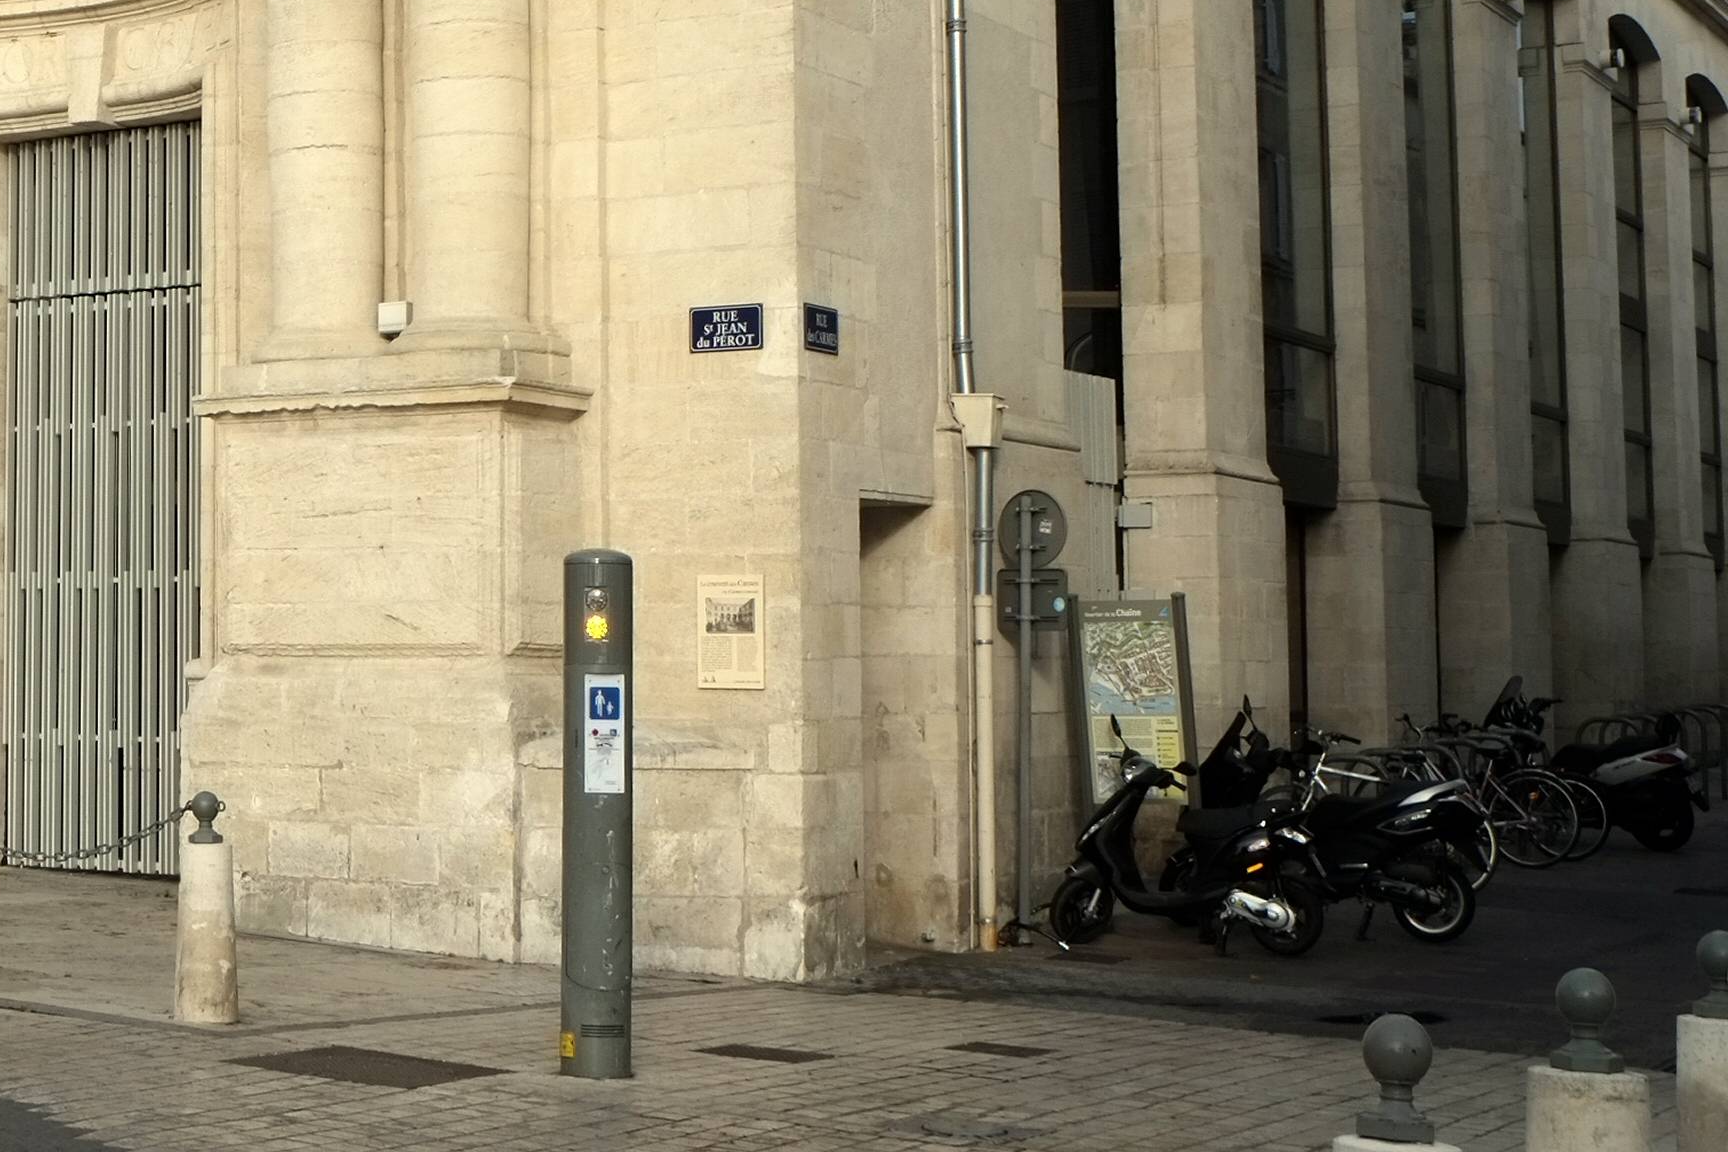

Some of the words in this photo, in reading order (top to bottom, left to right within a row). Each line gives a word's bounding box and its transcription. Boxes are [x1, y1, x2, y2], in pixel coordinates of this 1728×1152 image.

[712, 310, 739, 323] RUE
[815, 312, 828, 328] RUE
[703, 323, 713, 336] St
[715, 321, 747, 336] JEAN
[696, 336, 710, 348] du
